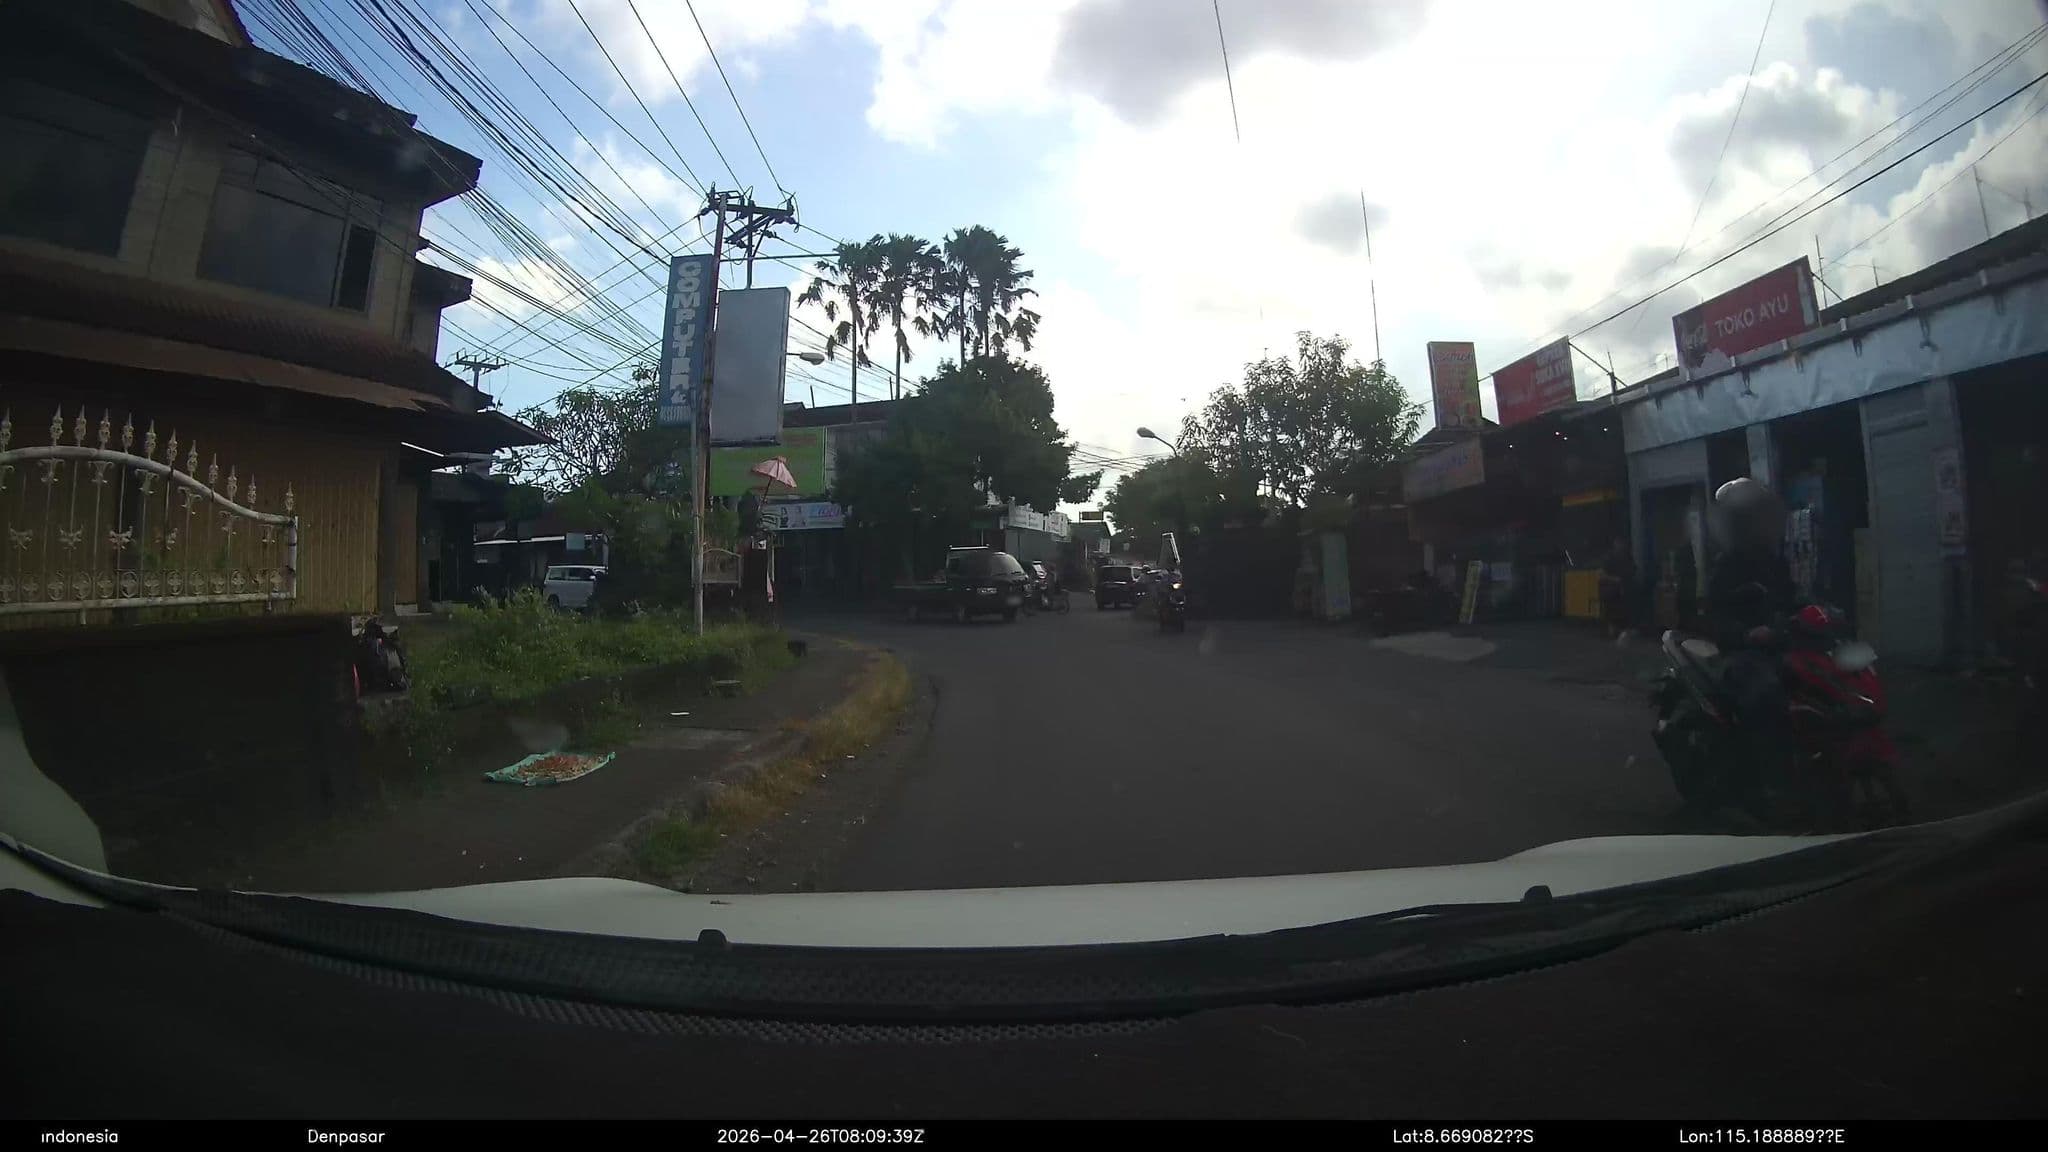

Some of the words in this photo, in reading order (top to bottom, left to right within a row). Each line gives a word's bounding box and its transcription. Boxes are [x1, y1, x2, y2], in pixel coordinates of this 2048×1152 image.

[670, 261, 701, 391] COMPUTER
[1714, 308, 1755, 338] TOKO
[1759, 293, 1789, 322] AYU
